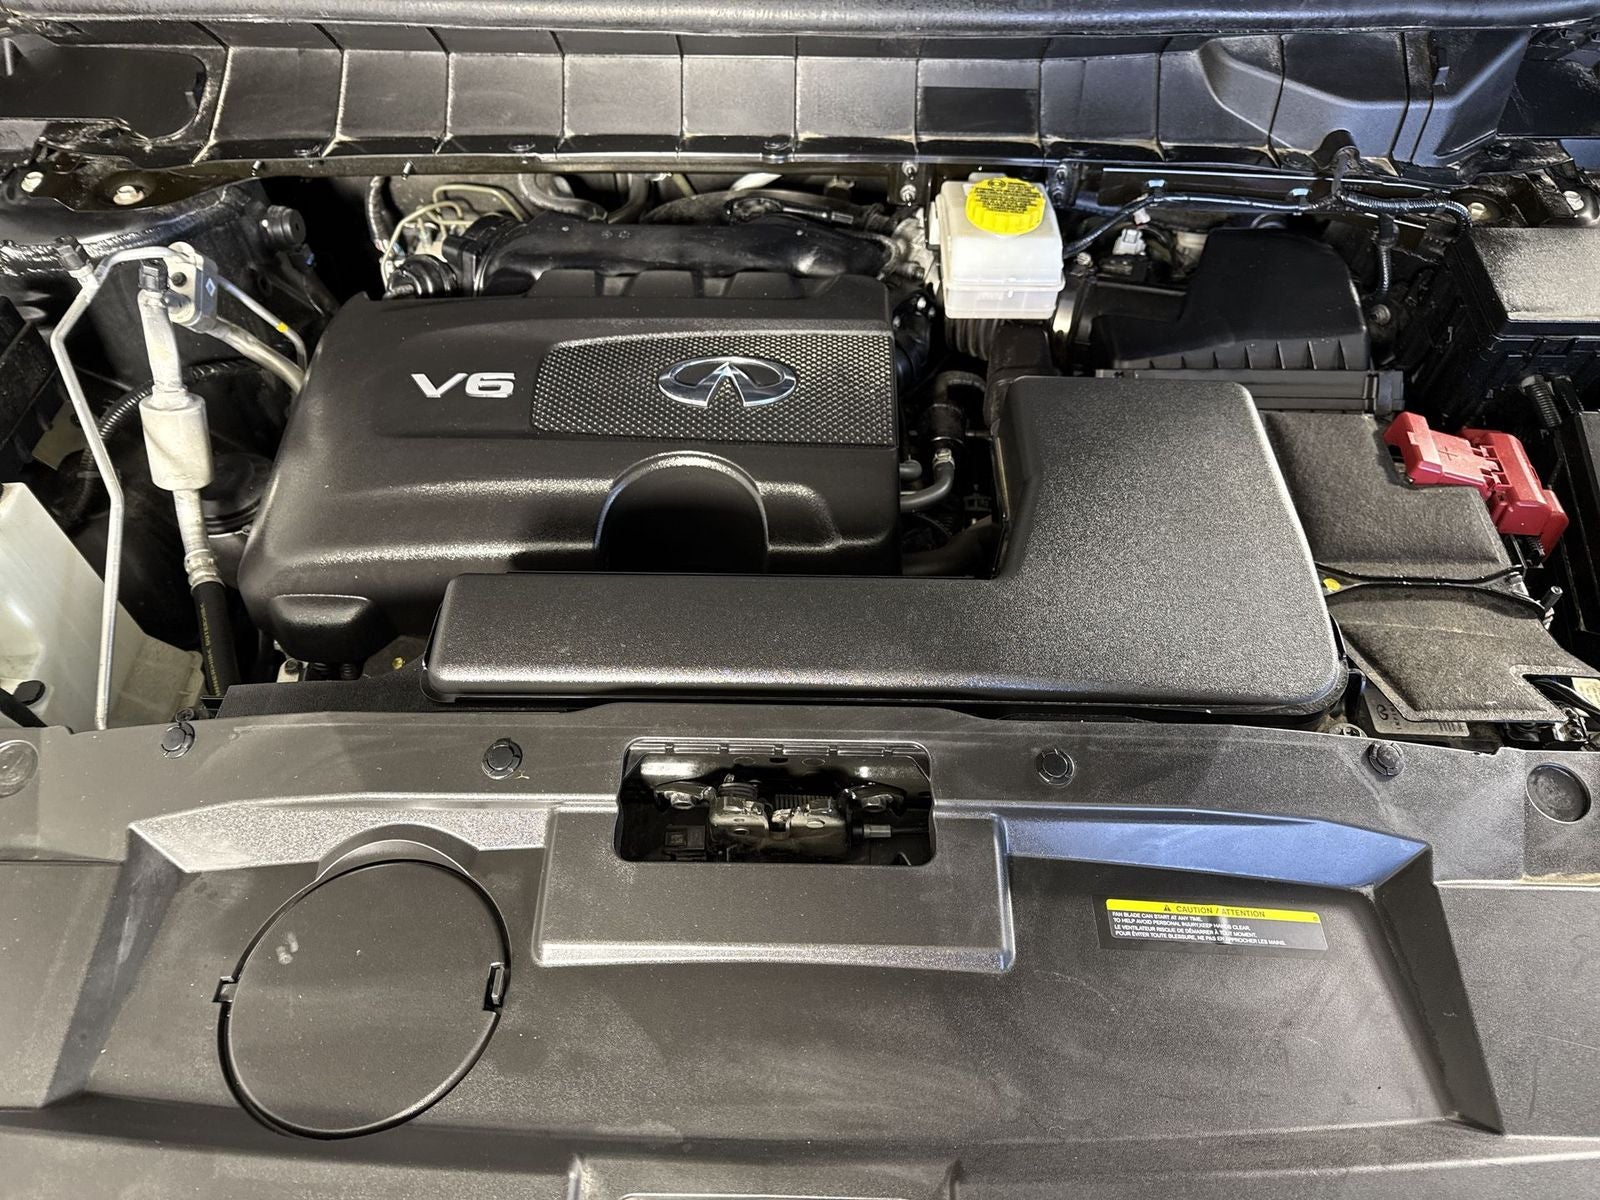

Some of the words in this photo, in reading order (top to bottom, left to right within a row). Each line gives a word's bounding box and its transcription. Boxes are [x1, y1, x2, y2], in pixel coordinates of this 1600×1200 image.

[411, 372, 516, 398] V6
[1176, 905, 1213, 914] CAUTION
[1222, 908, 1266, 917] ATTENTION
[1185, 927, 1213, 935] DÉMARRER
